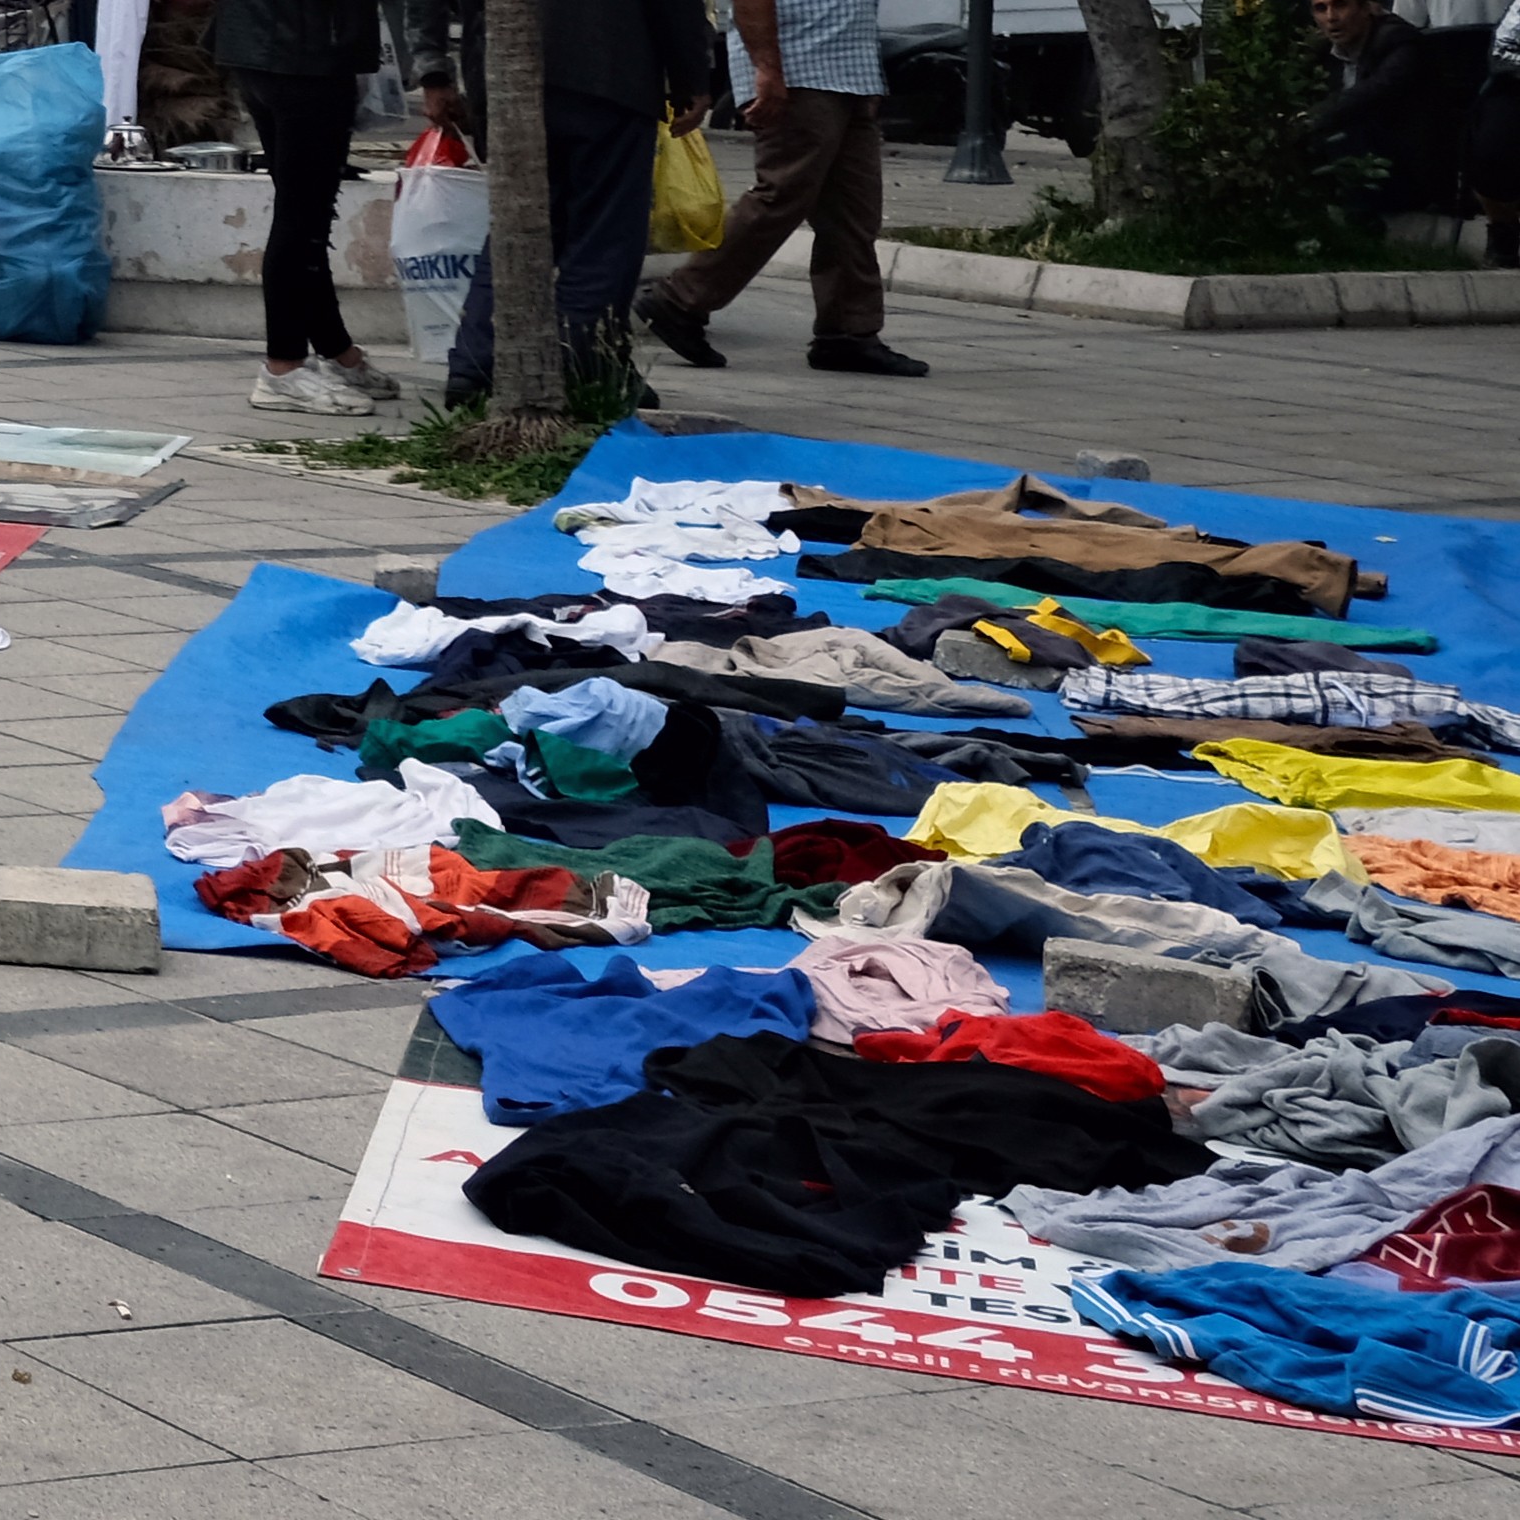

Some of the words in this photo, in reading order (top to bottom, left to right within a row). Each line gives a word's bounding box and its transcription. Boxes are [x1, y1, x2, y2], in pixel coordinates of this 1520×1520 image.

[588, 1271, 1034, 1363] 0544
[912, 1288, 1098, 1327] TES
[783, 1334, 951, 1370] e-mail
